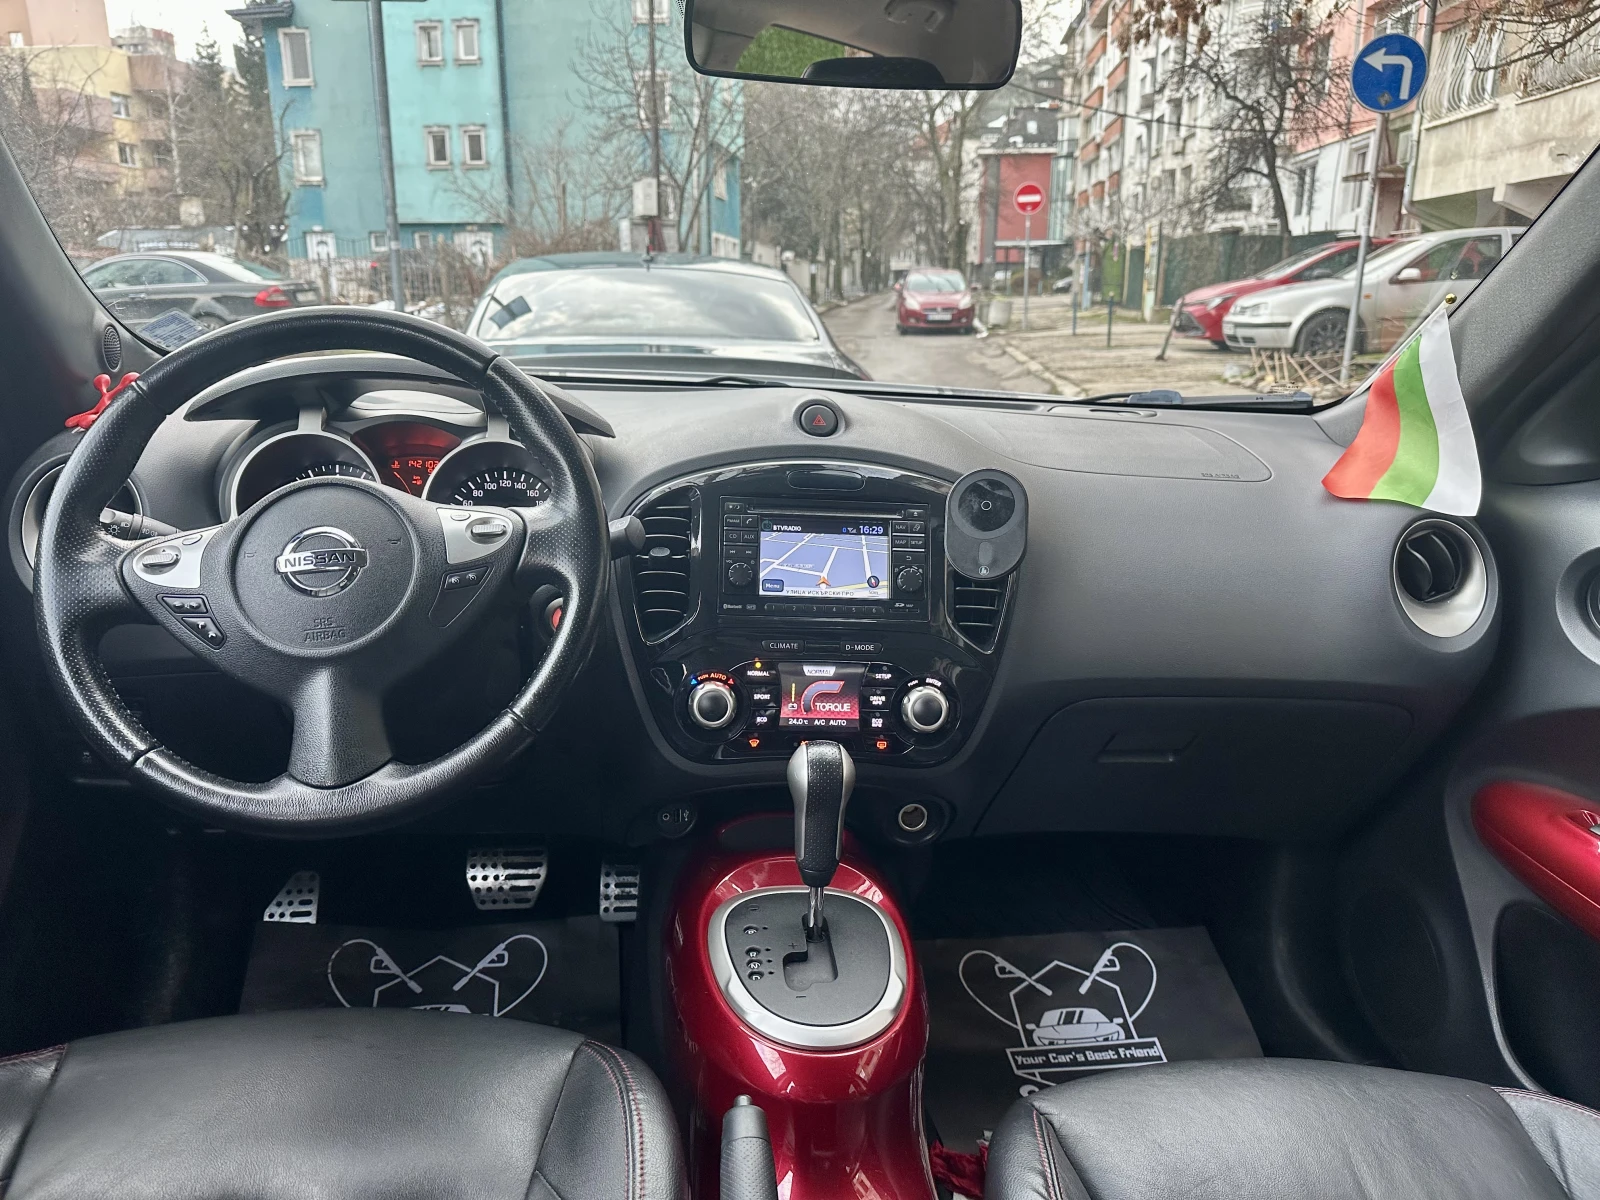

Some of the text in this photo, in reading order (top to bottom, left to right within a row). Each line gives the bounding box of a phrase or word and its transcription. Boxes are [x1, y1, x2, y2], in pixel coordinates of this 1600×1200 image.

[772, 524, 802, 532] BTVRADIO
[859, 525, 884, 534] 16:29
[284, 551, 356, 569] NISSAN
[313, 616, 333, 628] SRS
[304, 629, 346, 643] AIRBAG
[769, 642, 799, 650] CLIMATE
[845, 644, 875, 652] D-MODE
[709, 672, 727, 681] AUTO
[925, 677, 942, 687] ENTER
[814, 702, 851, 712] TORQUE
[1014, 1044, 1161, 1065] Your Car's Best Friend
